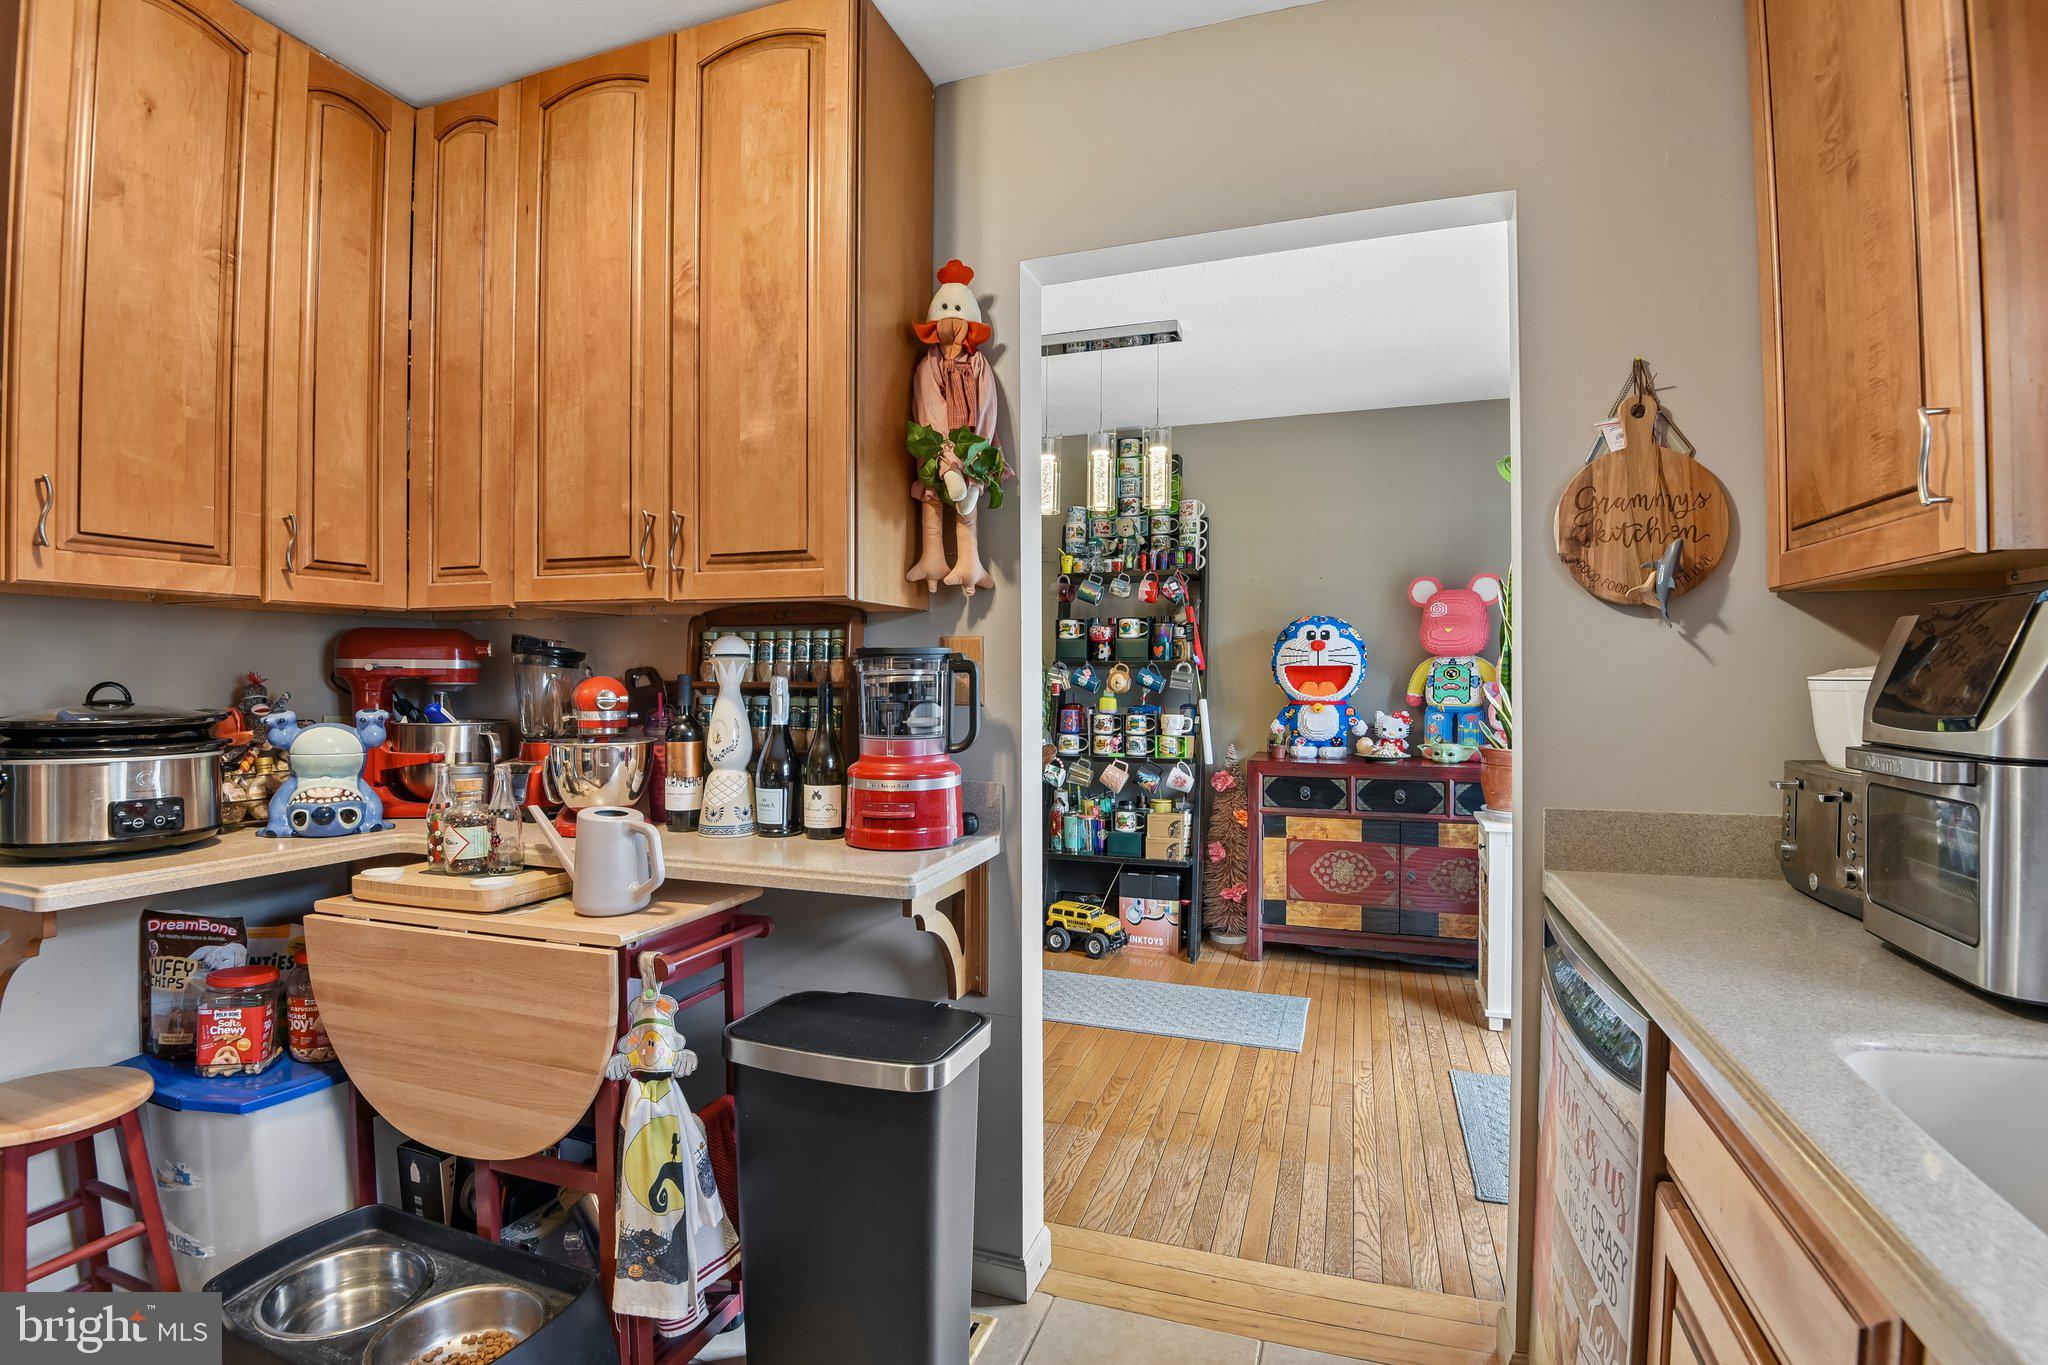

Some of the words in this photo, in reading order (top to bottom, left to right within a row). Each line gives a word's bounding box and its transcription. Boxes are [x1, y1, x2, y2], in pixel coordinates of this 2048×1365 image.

[1575, 560, 1601, 583] GOOD
[1601, 578, 1629, 595] FOOD
[1690, 554, 1714, 577] LOVE
[148, 919, 237, 936] DreamBone
[151, 958, 195, 977] UFFY
[215, 1010, 241, 1018] MILK-BONE
[218, 1019, 237, 1028] Soft
[209, 1025, 247, 1036] Chewy
[1557, 1053, 1581, 1157] This
[1585, 1114, 1600, 1188] is
[1604, 1158, 1631, 1235] us
[1591, 1203, 1628, 1284] CRAZY
[1590, 1239, 1618, 1308] LOUD
